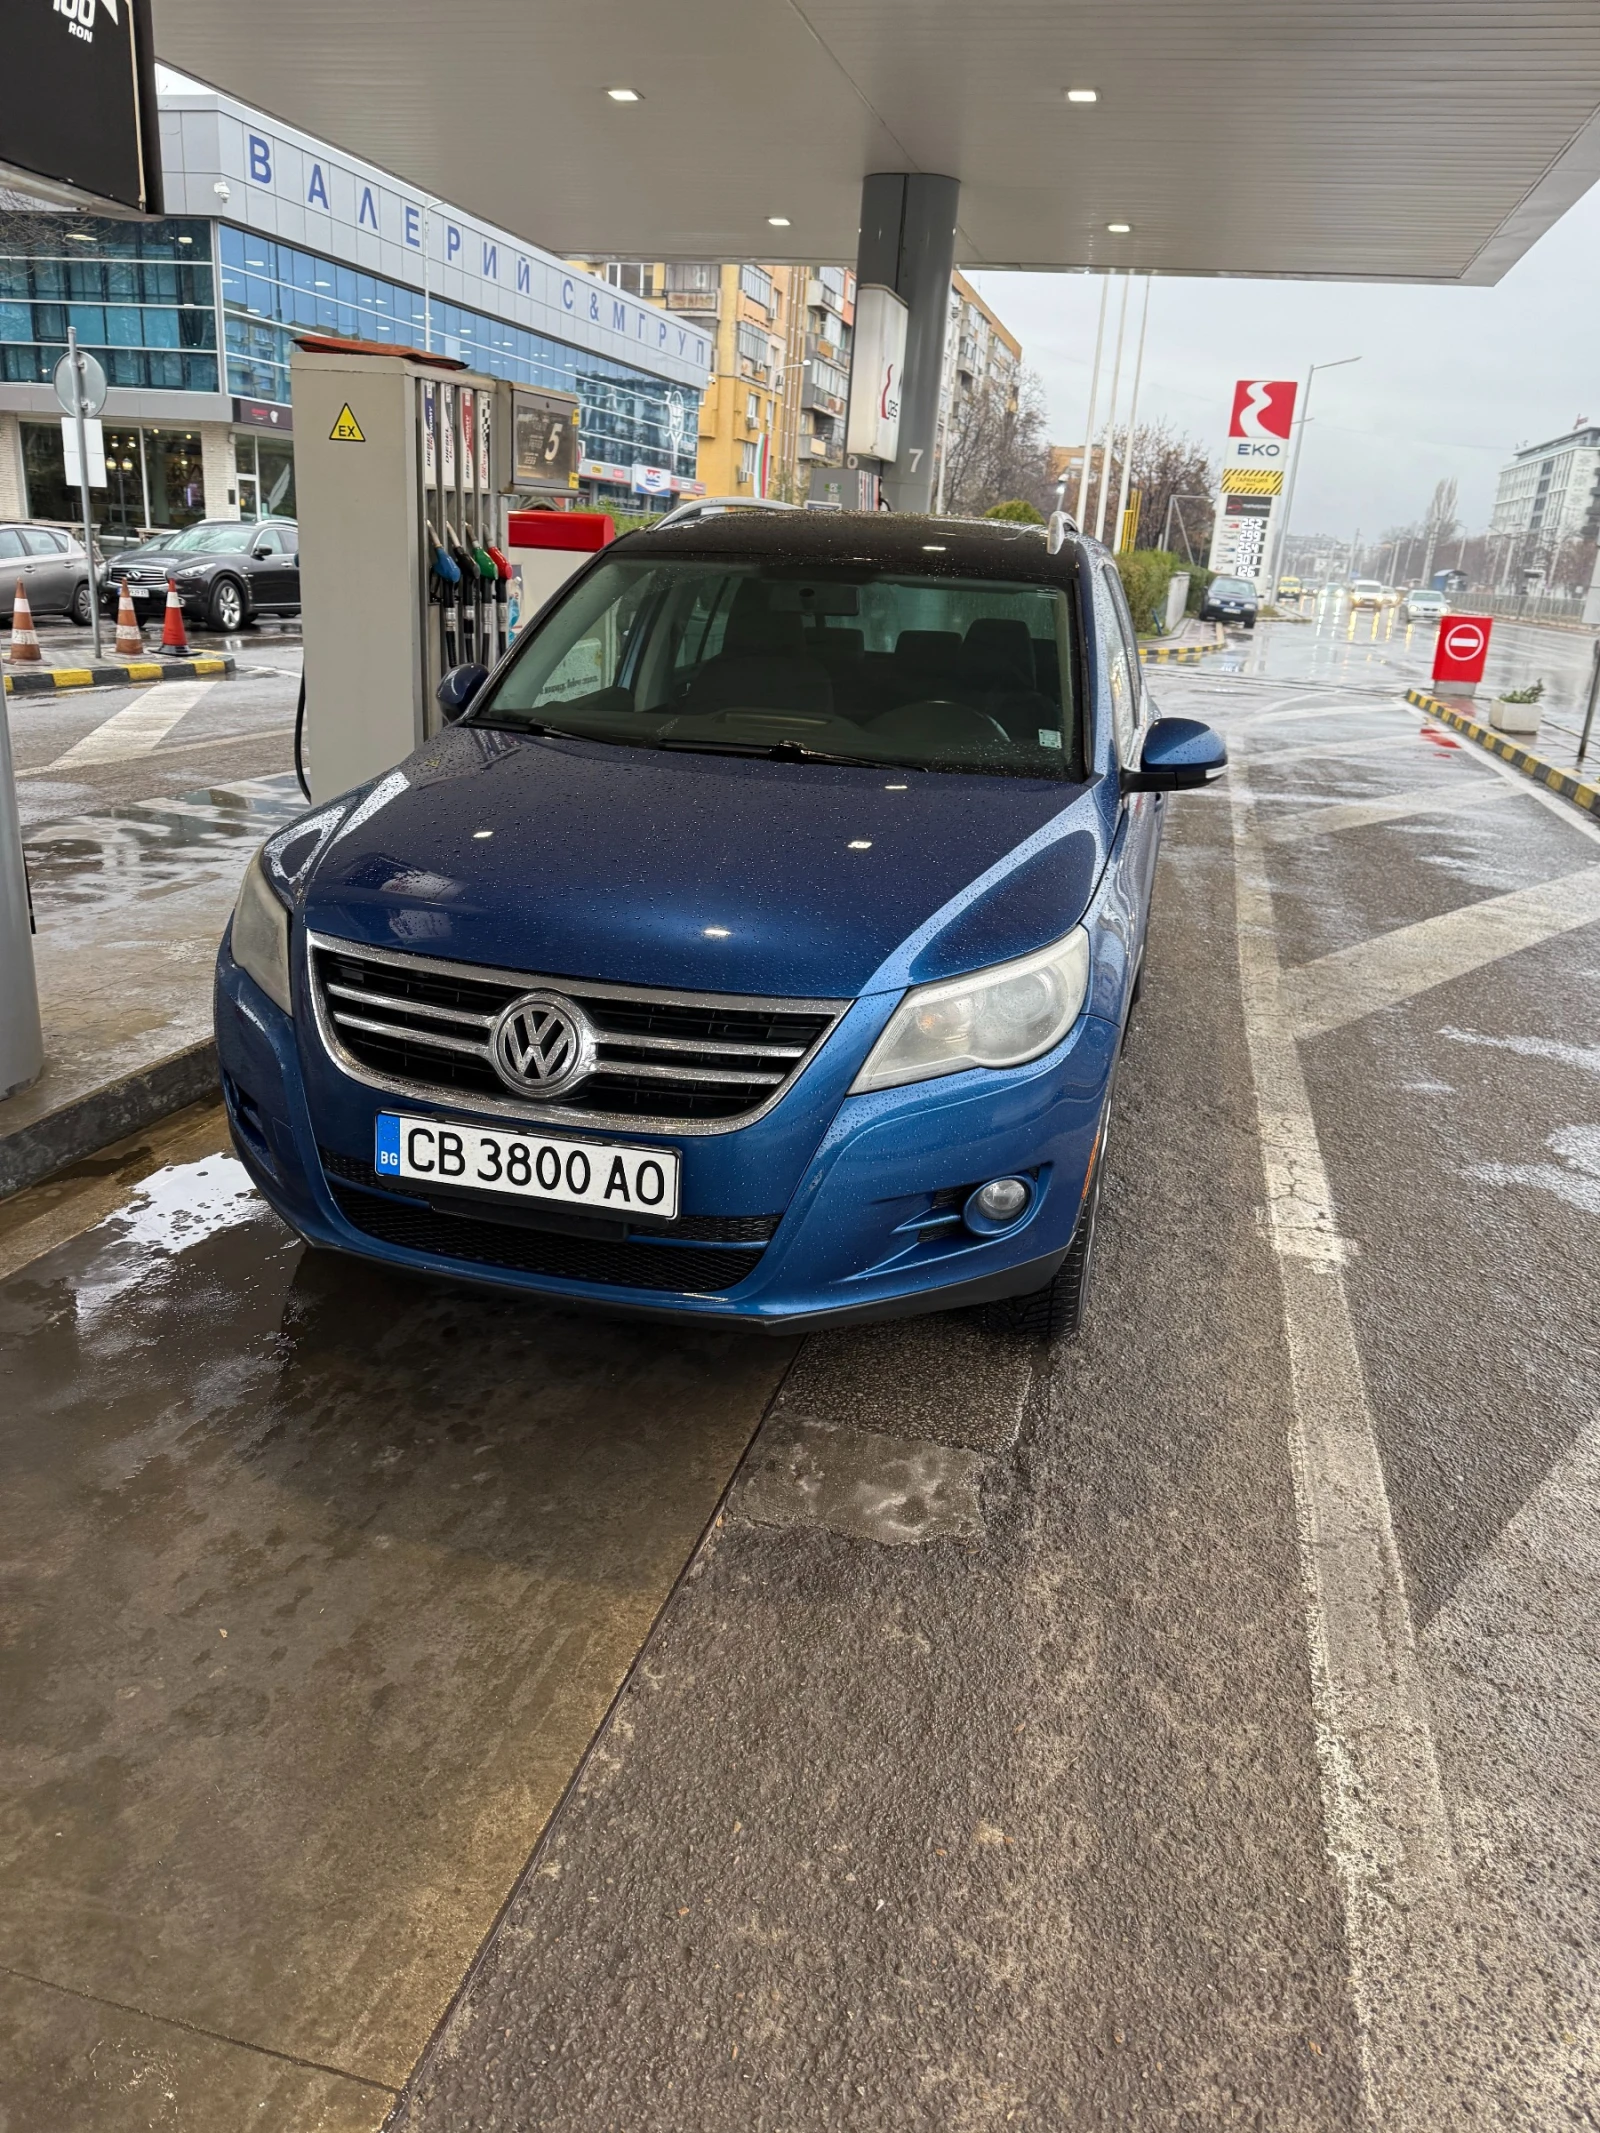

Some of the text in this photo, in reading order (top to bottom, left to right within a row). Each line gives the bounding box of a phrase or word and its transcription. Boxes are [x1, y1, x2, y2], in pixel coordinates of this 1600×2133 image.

[68, 21, 93, 43] RON
[249, 134, 530, 294] ВАЛЕРИЙ
[338, 425, 356, 437] EX
[544, 423, 564, 461] 5
[909, 448, 924, 473] 7
[1237, 443, 1280, 457] EKO
[380, 1151, 398, 1166] BG
[407, 1127, 666, 1206] CB 3800 AO
